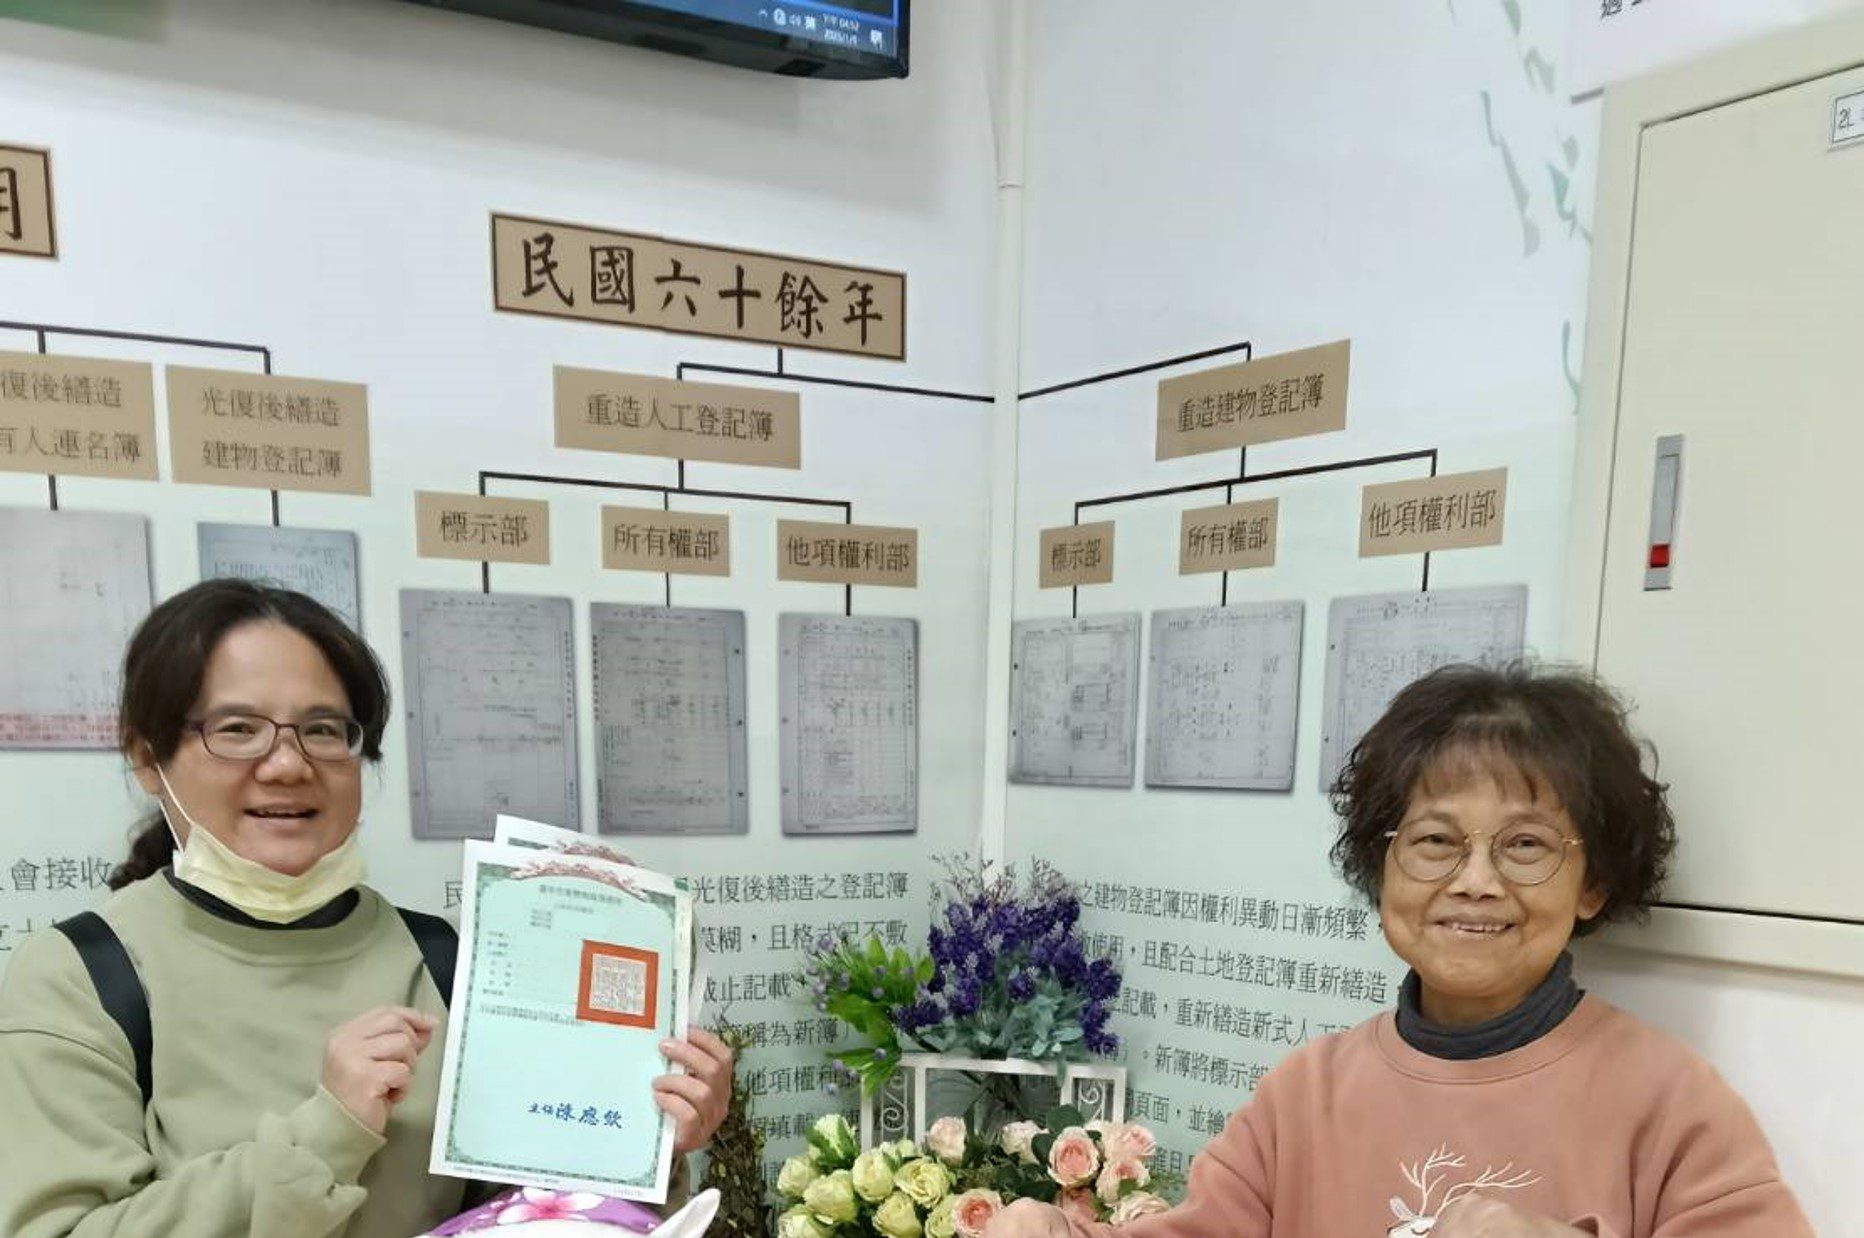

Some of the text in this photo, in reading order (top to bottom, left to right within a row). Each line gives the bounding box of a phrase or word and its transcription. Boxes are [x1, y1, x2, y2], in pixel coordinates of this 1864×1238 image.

[520, 231, 883, 347] 民國六十餘年
[201, 384, 341, 428] 光復後繕造
[585, 392, 774, 442] 重造人工登記簿
[1177, 372, 1325, 433] 重造建物登記簿
[201, 438, 344, 479] 建物登記簿
[440, 509, 529, 548] 標示部
[1367, 488, 1499, 539] 他項權利部
[612, 523, 721, 562] 所有權部
[785, 535, 912, 574] 他項權利部
[1050, 537, 1102, 572] 標示部
[1185, 515, 1270, 557] 所有權部
